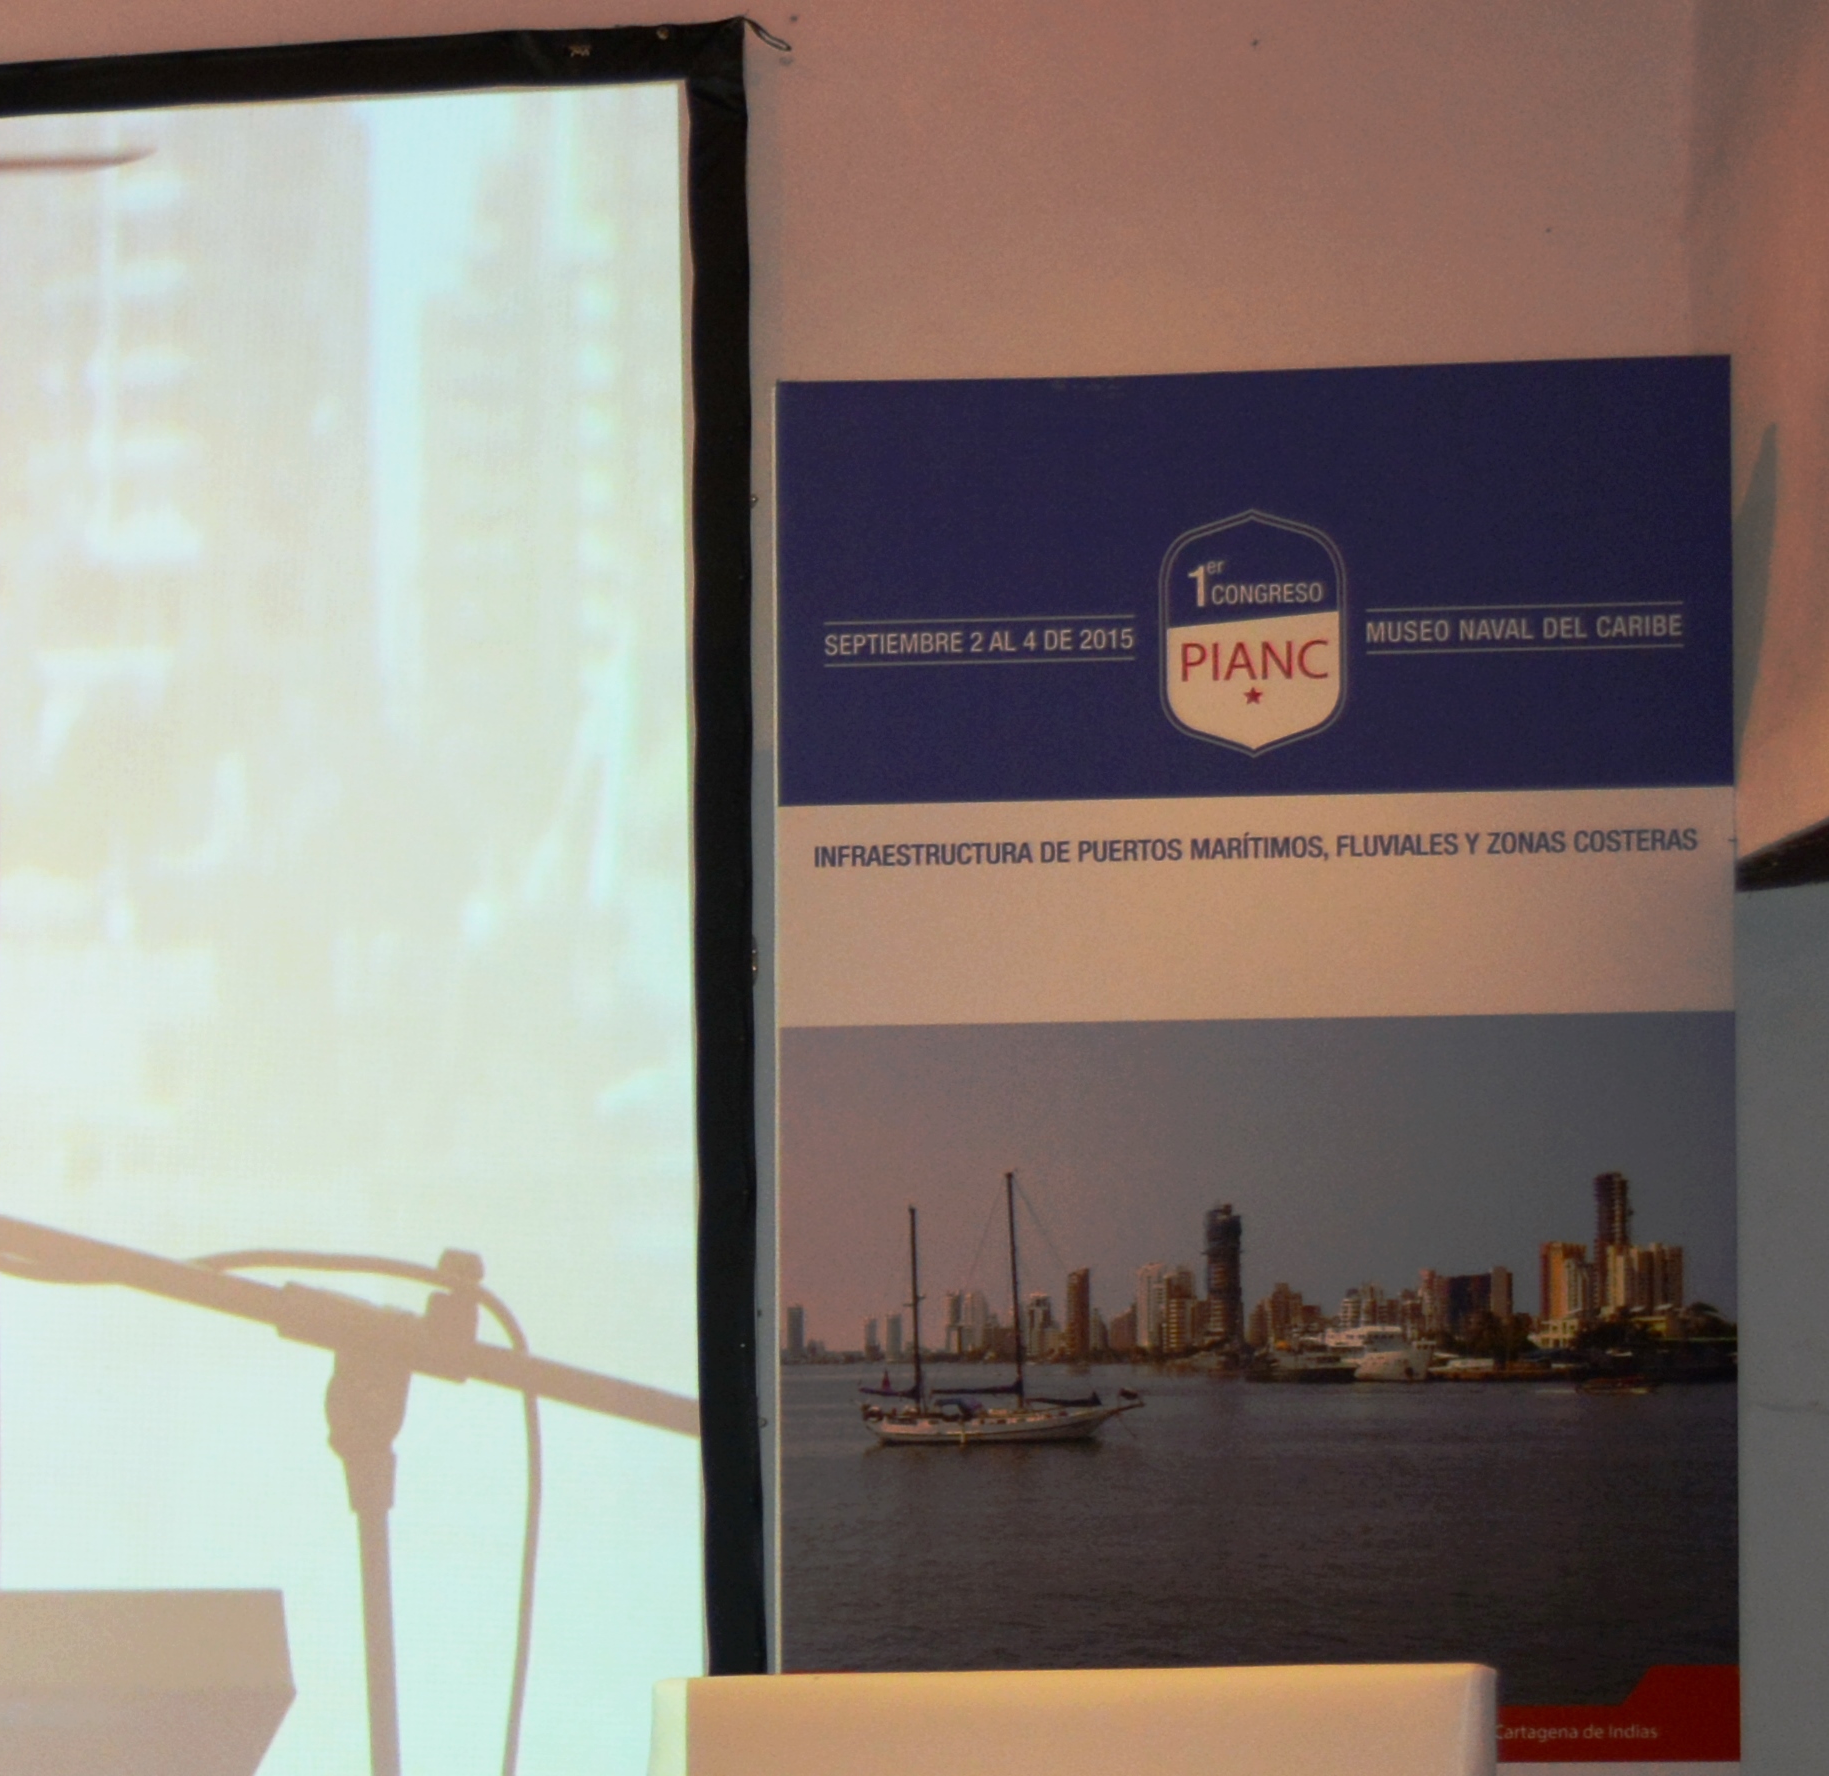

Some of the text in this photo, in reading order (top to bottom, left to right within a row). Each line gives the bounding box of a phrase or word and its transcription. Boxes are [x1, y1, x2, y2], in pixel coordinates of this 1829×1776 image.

[1211, 581, 1324, 606] CONGRESO
[824, 627, 1135, 657] SEPTIEMBRE 2 AL 4 DE 2015
[1365, 614, 1682, 644] MUSEO NAVAL DEL CARIBE
[1181, 638, 1329, 682] PIANC
[814, 828, 1698, 868] INFRAESTRUCTURA DE PUERTOS MARÍTIMOS, FLUVIALES Y ZONAS COSTERAS
[1582, 1724, 1605, 1740] de
[1608, 1724, 1659, 1739] Indias
